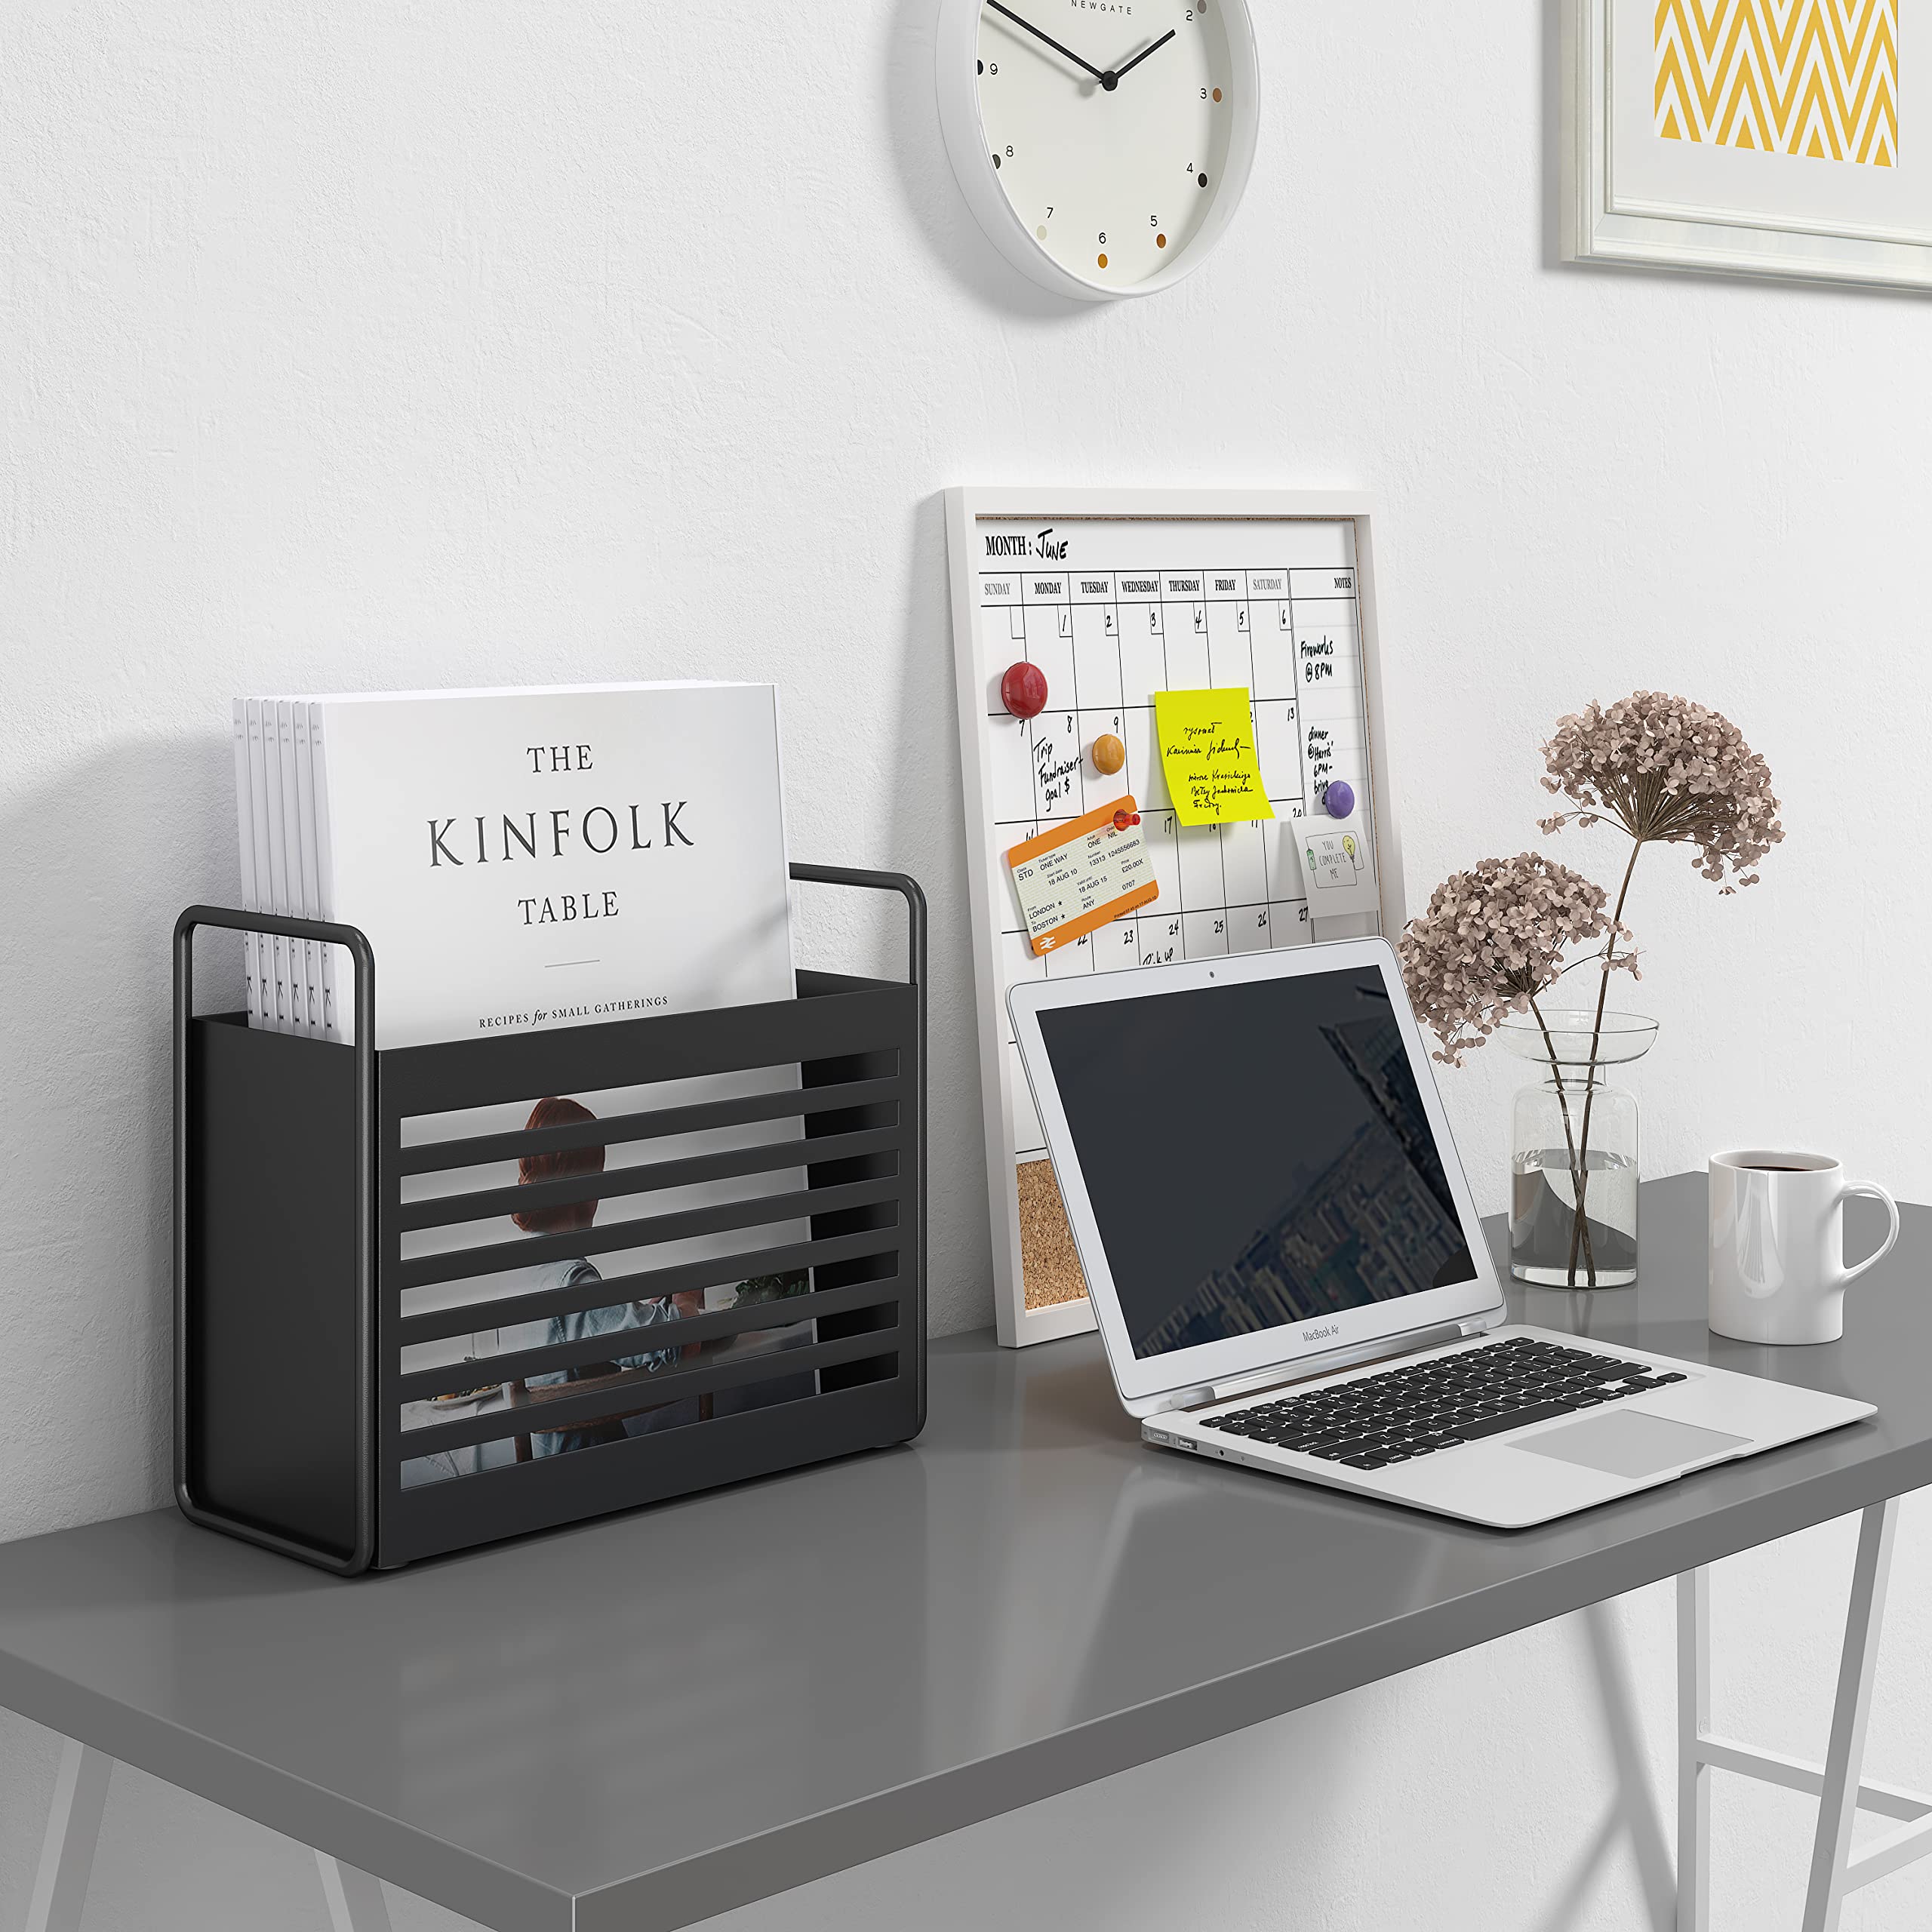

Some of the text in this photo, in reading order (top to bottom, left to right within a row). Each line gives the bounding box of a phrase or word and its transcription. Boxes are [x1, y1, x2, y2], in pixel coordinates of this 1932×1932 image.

[1071, 0, 1132, 15] NEWGATE
[1186, 10, 1193, 21] 2
[989, 63, 998, 75] 9
[1200, 88, 1208, 99] 3
[1006, 146, 1014, 157] 8
[1186, 162, 1194, 174] 4
[1047, 207, 1054, 219] 7
[1150, 215, 1158, 226] 5
[1098, 232, 1106, 244] 6
[984, 577, 1352, 595] SUNDAY MONDAY TUESDAY WEDNESDAY THURSDAY FRIDAY SATURDAY NOTES
[1106, 615, 1112, 628] 2
[1151, 612, 1156, 627] 3
[1195, 610, 1202, 630] 4
[1239, 611, 1244, 626] 5
[1282, 610, 1287, 625] 6
[1019, 707, 1295, 737] 7 8 9 13
[1033, 737, 1053, 762] Trip
[526, 744, 595, 774] THE
[1164, 816, 1173, 835] 17
[427, 801, 695, 869] KINFOLK
[1088, 831, 1118, 848] ONE NIL
[1321, 841, 1334, 851] YOU
[1040, 853, 1068, 871] ONE WAY
[1089, 855, 1106, 866] 13313
[1318, 852, 1346, 866] COMPLETE
[1018, 869, 1034, 881] STD
[1057, 872, 1069, 883] AUG
[1330, 868, 1339, 880] ME
[1086, 879, 1100, 890] AUG
[1121, 879, 1135, 891] 0707
[518, 891, 620, 926] TABLE
[1029, 903, 1055, 919] LONDON
[1083, 900, 1095, 909] ANY
[1032, 915, 1058, 933] BOSTON
[1124, 930, 1134, 945] 23
[1169, 918, 1179, 936] 24
[1214, 920, 1224, 934] 25
[1257, 911, 1266, 928] 26
[1298, 906, 1309, 922] 27
[478, 996, 669, 1029] RECIPES for SMALL GATHERINGS
[1303, 1326, 1331, 1342] MacBook
